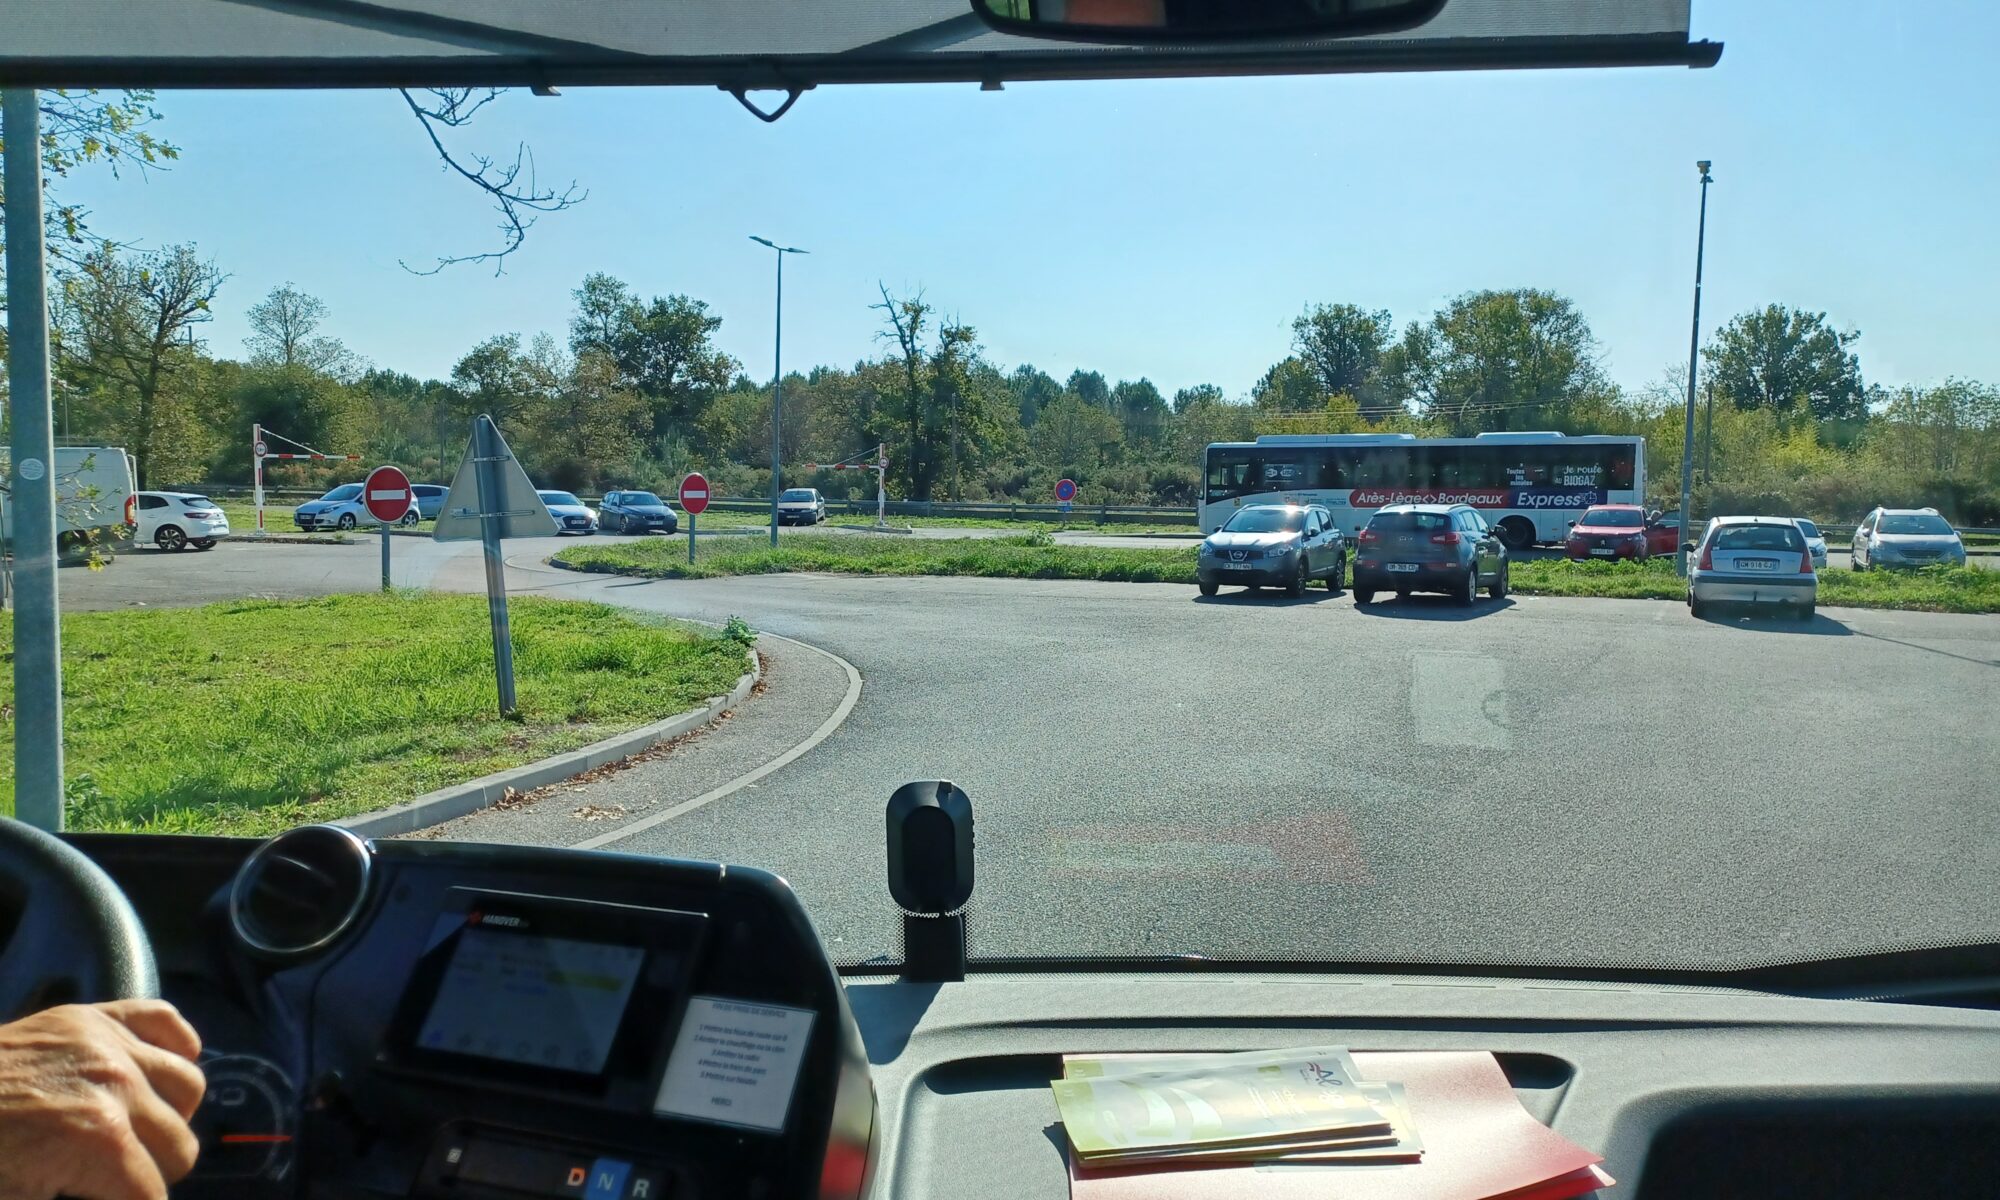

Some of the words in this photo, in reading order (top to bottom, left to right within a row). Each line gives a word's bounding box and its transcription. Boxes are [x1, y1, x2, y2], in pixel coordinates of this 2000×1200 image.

[1563, 465, 1575, 475] Je
[1577, 463, 1603, 474] roule
[1563, 475, 1596, 486] BIOGAZ
[1517, 492, 1581, 508] Express
[482, 914, 520, 927] HANOVER
[567, 1168, 586, 1187] D
[597, 1173, 614, 1191] N
[633, 1179, 650, 1198] R
